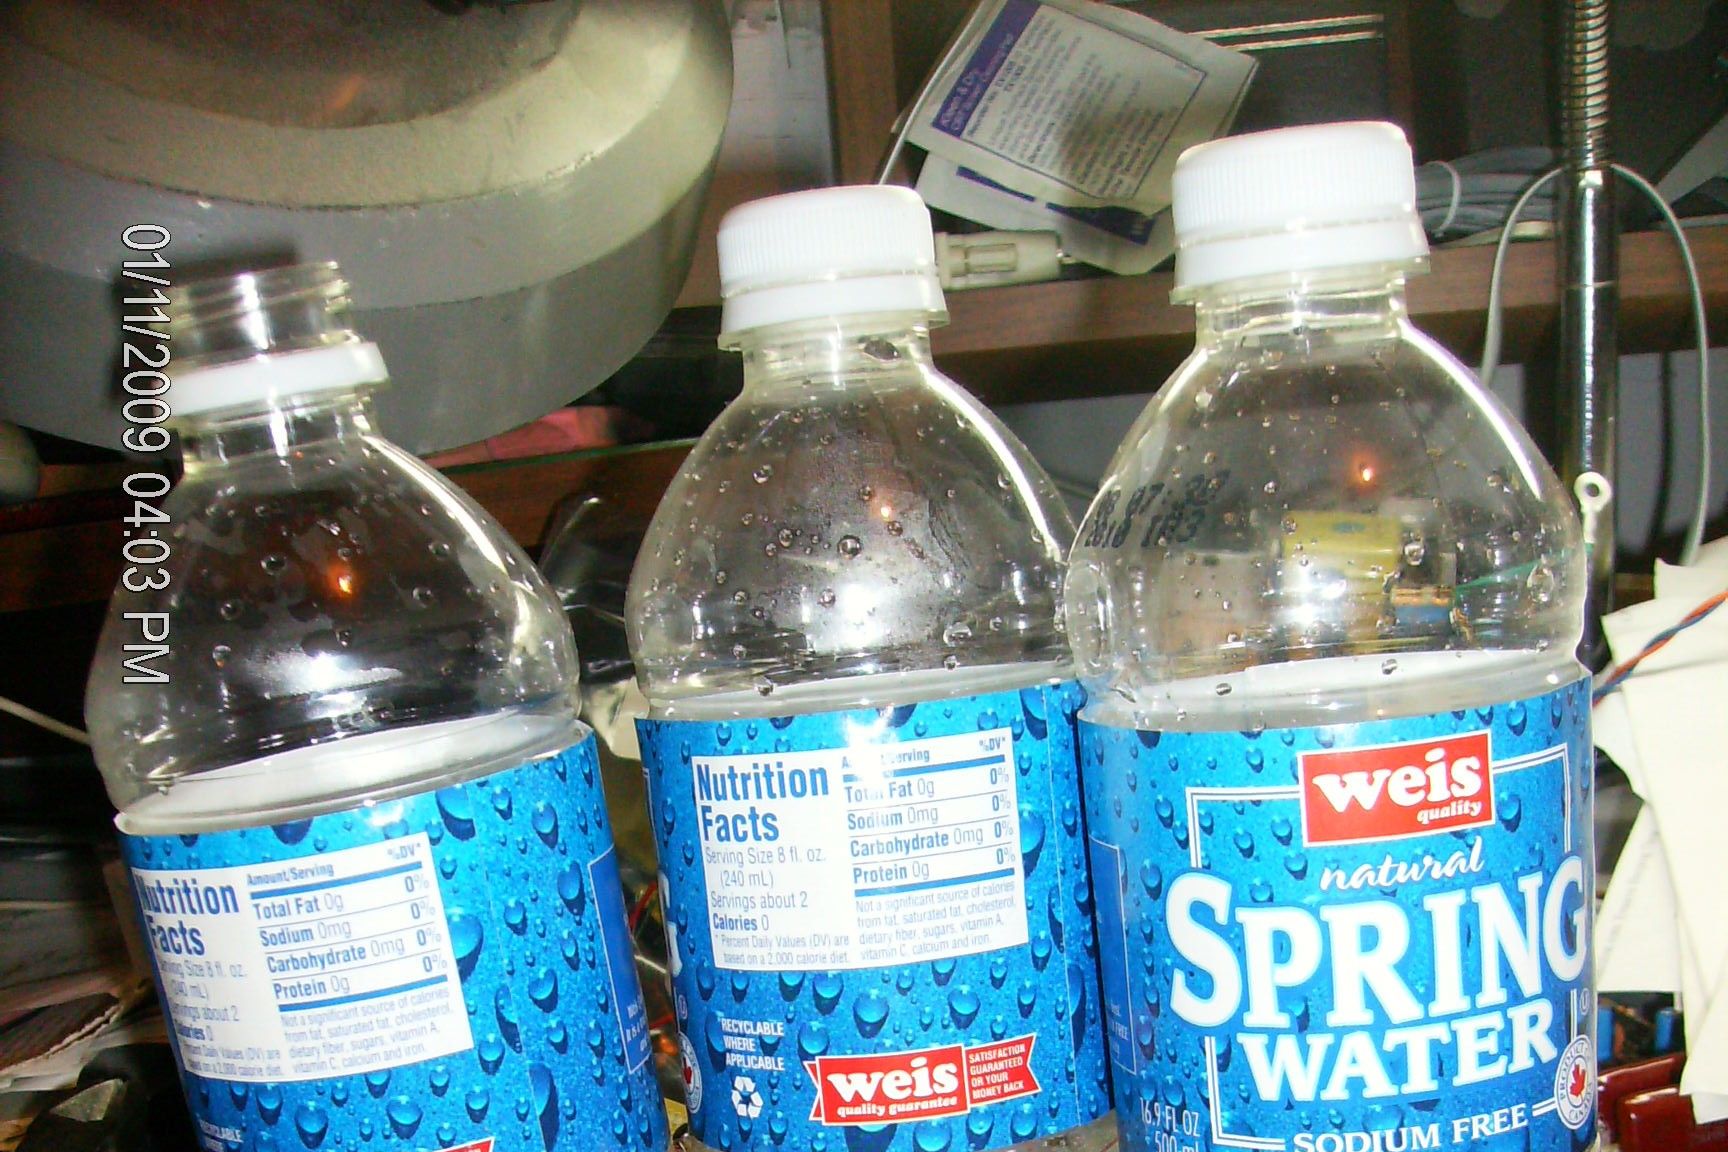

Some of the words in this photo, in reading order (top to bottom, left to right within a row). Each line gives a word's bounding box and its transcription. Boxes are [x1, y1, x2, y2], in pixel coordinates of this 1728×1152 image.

[697, 762, 828, 800] Nutrition
[844, 786, 883, 803] Totl
[889, 780, 912, 798] Fat
[917, 778, 934, 798] 0g
[990, 768, 1009, 784] 0%
[1313, 748, 1483, 813] weis
[701, 805, 779, 842] Facts
[848, 812, 902, 830] Sodium
[908, 806, 938, 824] 0mg
[992, 795, 1011, 811] 0%
[1417, 801, 1482, 825] quality
[851, 832, 949, 857] Carbohydrate
[954, 828, 983, 845] 0mg
[994, 821, 1013, 838] 0%
[705, 847, 744, 868] Serving
[749, 847, 773, 864] Size
[778, 847, 785, 863] 8
[790, 846, 802, 862] fl.
[807, 849, 825, 862] oz.
[854, 865, 907, 884] Protein
[912, 861, 929, 879] 0g
[997, 848, 1015, 865] 0%
[1320, 837, 1485, 890] natural
[720, 870, 745, 887] (240
[749, 870, 774, 887] mL)
[982, 880, 1015, 896] calories
[135, 875, 239, 915] Nutrition
[253, 900, 291, 920] Total
[296, 898, 320, 914] Fat
[324, 892, 344, 911] 0g
[405, 875, 429, 892] 0%
[710, 891, 756, 912] Servings
[760, 892, 796, 908] about
[800, 892, 808, 907] 2
[146, 915, 205, 955] Facts
[260, 927, 314, 946] Sodium
[318, 921, 351, 939] 0mg
[411, 901, 435, 919] 0%
[713, 913, 758, 931] Calories
[762, 914, 769, 930] 0
[960, 917, 993, 931] vitamin
[267, 945, 366, 973] Carbohydrate
[371, 937, 404, 957] 0mg
[417, 928, 441, 946] 0%
[775, 934, 805, 947] Values
[1165, 857, 1587, 1028] SPRING
[161, 960, 184, 978] rving
[274, 979, 326, 999] Protein
[330, 975, 350, 993] 0g
[423, 954, 447, 972] 0%
[231, 1006, 239, 1021] 2
[721, 1019, 784, 1036] RECYCLABLE
[175, 1019, 205, 1040] lories
[724, 1036, 756, 1051] WHERE
[726, 1055, 785, 1071] APPLICABLE
[969, 1044, 1025, 1063] SATISFACTION
[1237, 999, 1559, 1100] WATER
[827, 1057, 958, 1102] weis
[970, 1058, 1023, 1075] GUARANTEED
[971, 1076, 983, 1086] OR
[986, 1072, 1008, 1085] YOUR
[972, 1088, 1001, 1100] MONEY
[1004, 1081, 1023, 1093] BACK
[837, 1103, 885, 1117] quality
[889, 1096, 957, 1115] guarantee
[1140, 1097, 1161, 1124] 16.9
[1165, 1106, 1179, 1133] FL
[1182, 1110, 1200, 1137] OZ
[1452, 1103, 1529, 1142] FREE
